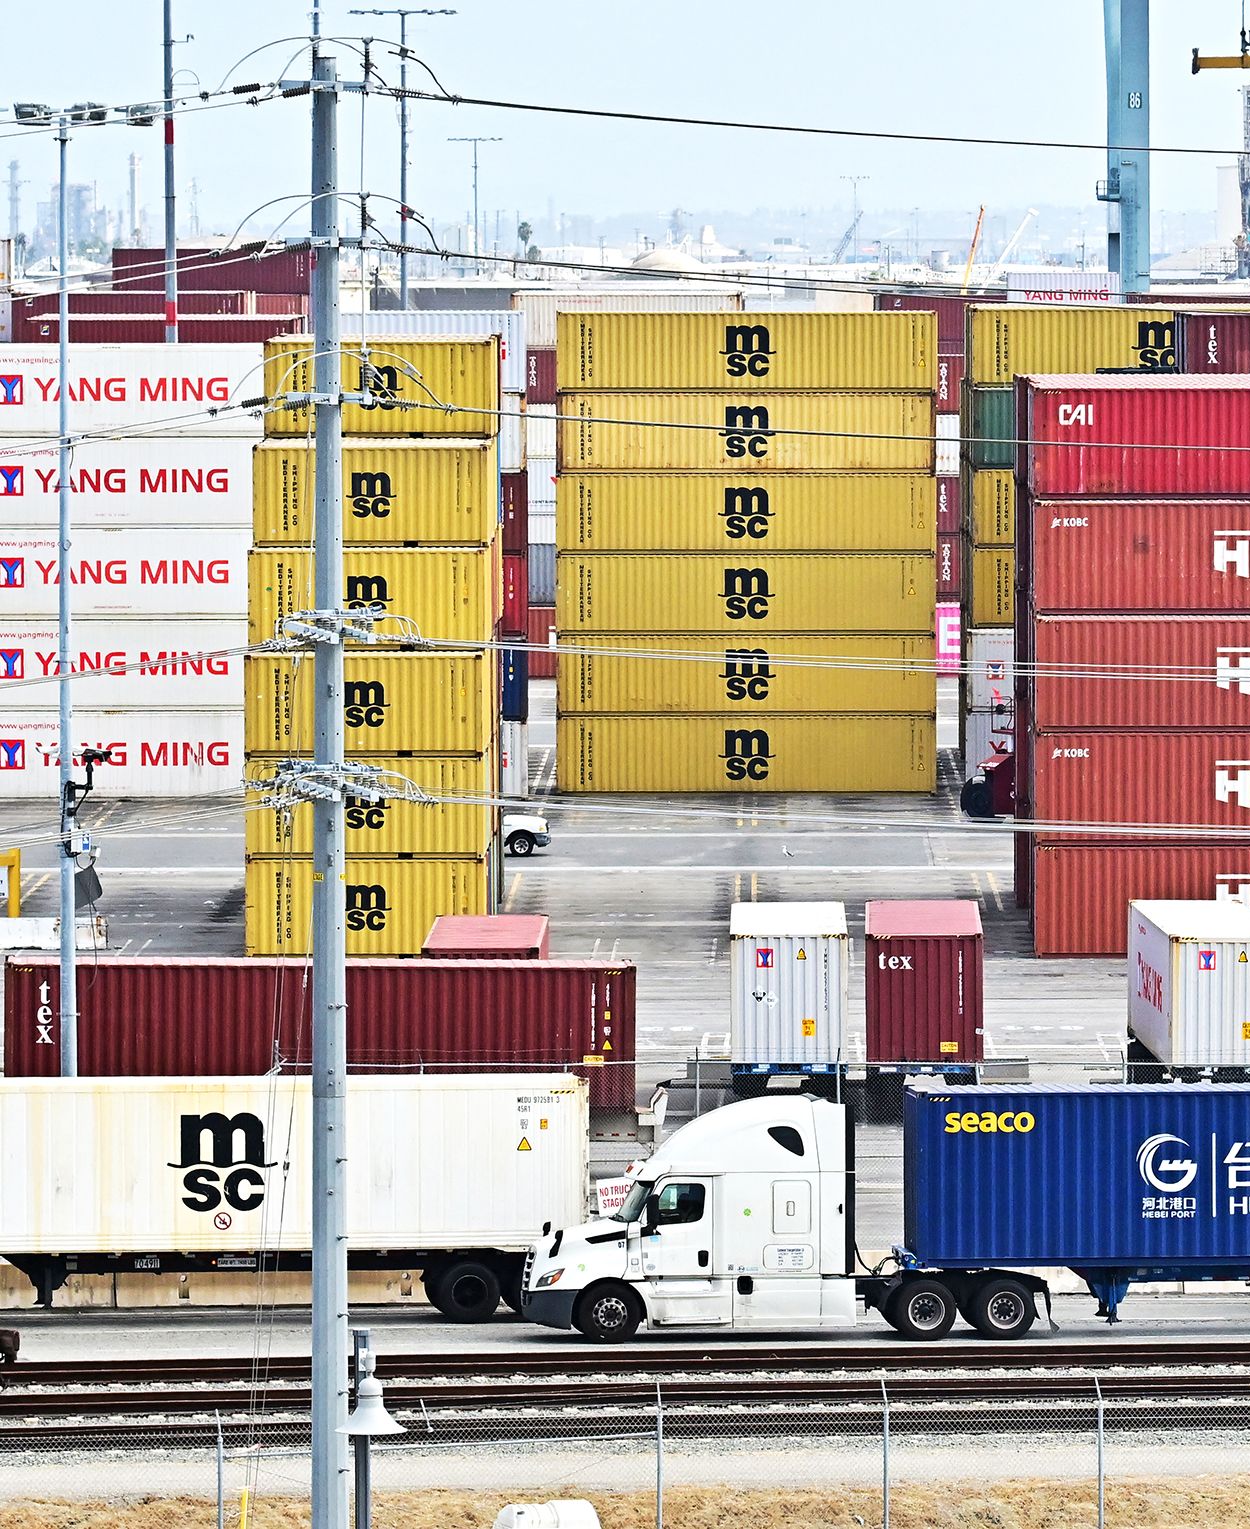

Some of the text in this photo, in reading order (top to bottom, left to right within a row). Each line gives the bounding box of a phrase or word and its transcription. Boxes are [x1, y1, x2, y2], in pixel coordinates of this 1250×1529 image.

[1129, 93, 1142, 108] 86
[1024, 289, 1109, 301] YANG MING
[1207, 324, 1218, 364] tex
[529, 356, 537, 387] TRITON
[939, 363, 948, 400] TRITON
[140, 377, 229, 402] MING
[1058, 404, 1094, 426] CAI
[140, 469, 229, 493] MING
[939, 483, 948, 512] tex
[1063, 517, 1089, 527] KOBC
[140, 560, 229, 584] MING
[942, 544, 951, 581] TRITON
[140, 651, 229, 676] MING
[141, 741, 229, 767] MING
[1064, 748, 1090, 757] KOBC
[878, 951, 913, 971] tex
[36, 980, 55, 1045] tex
[516, 1096, 532, 1104] MEDU
[944, 1111, 1036, 1133] seaco
[599, 1187, 610, 1197] NO
[602, 1198, 626, 1208] STAGI
[1142, 1197, 1197, 1210] 河北港口
[1142, 1210, 1197, 1218] HEBEI PORT
